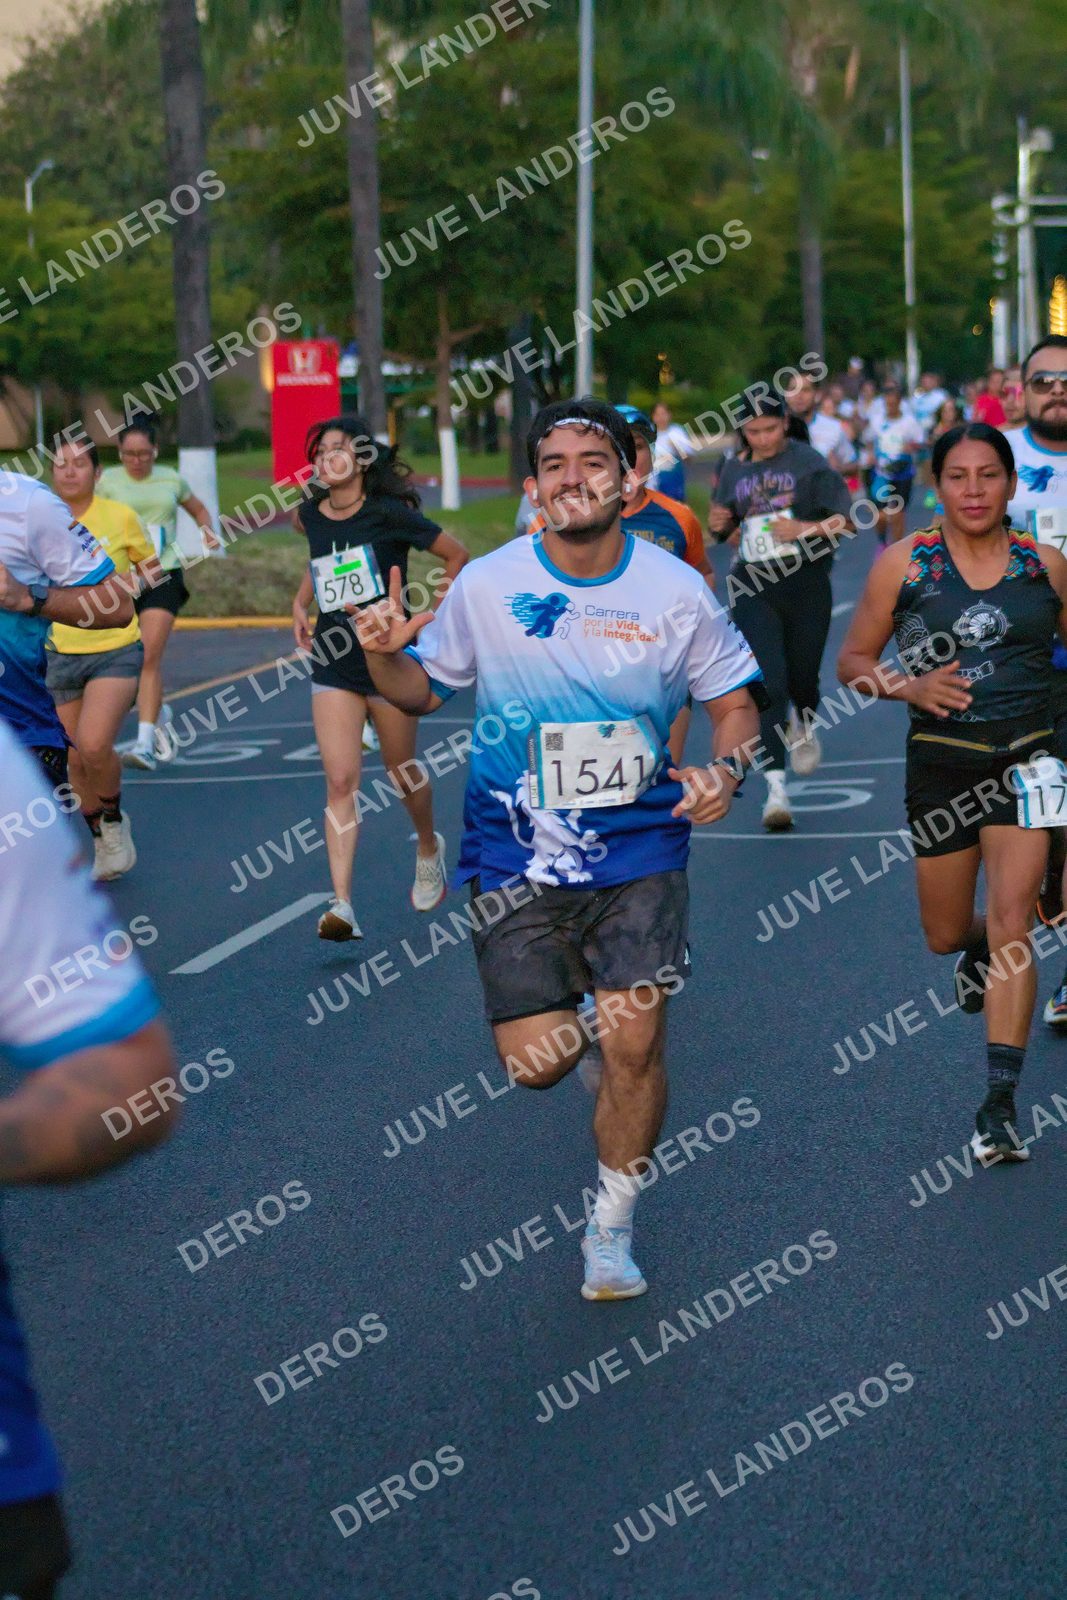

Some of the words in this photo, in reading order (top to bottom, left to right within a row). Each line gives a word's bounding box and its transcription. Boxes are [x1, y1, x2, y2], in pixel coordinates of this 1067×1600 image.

[324, 573, 364, 604] 578
[584, 604, 640, 621] Carrera
[584, 618, 602, 628] por
[604, 619, 614, 628] la
[616, 619, 640, 631] Vida
[583, 627, 590, 637] y
[591, 627, 601, 637] la
[603, 628, 661, 643] Integridad
[550, 754, 645, 797] 1541
[1033, 784, 1066, 816] 17
